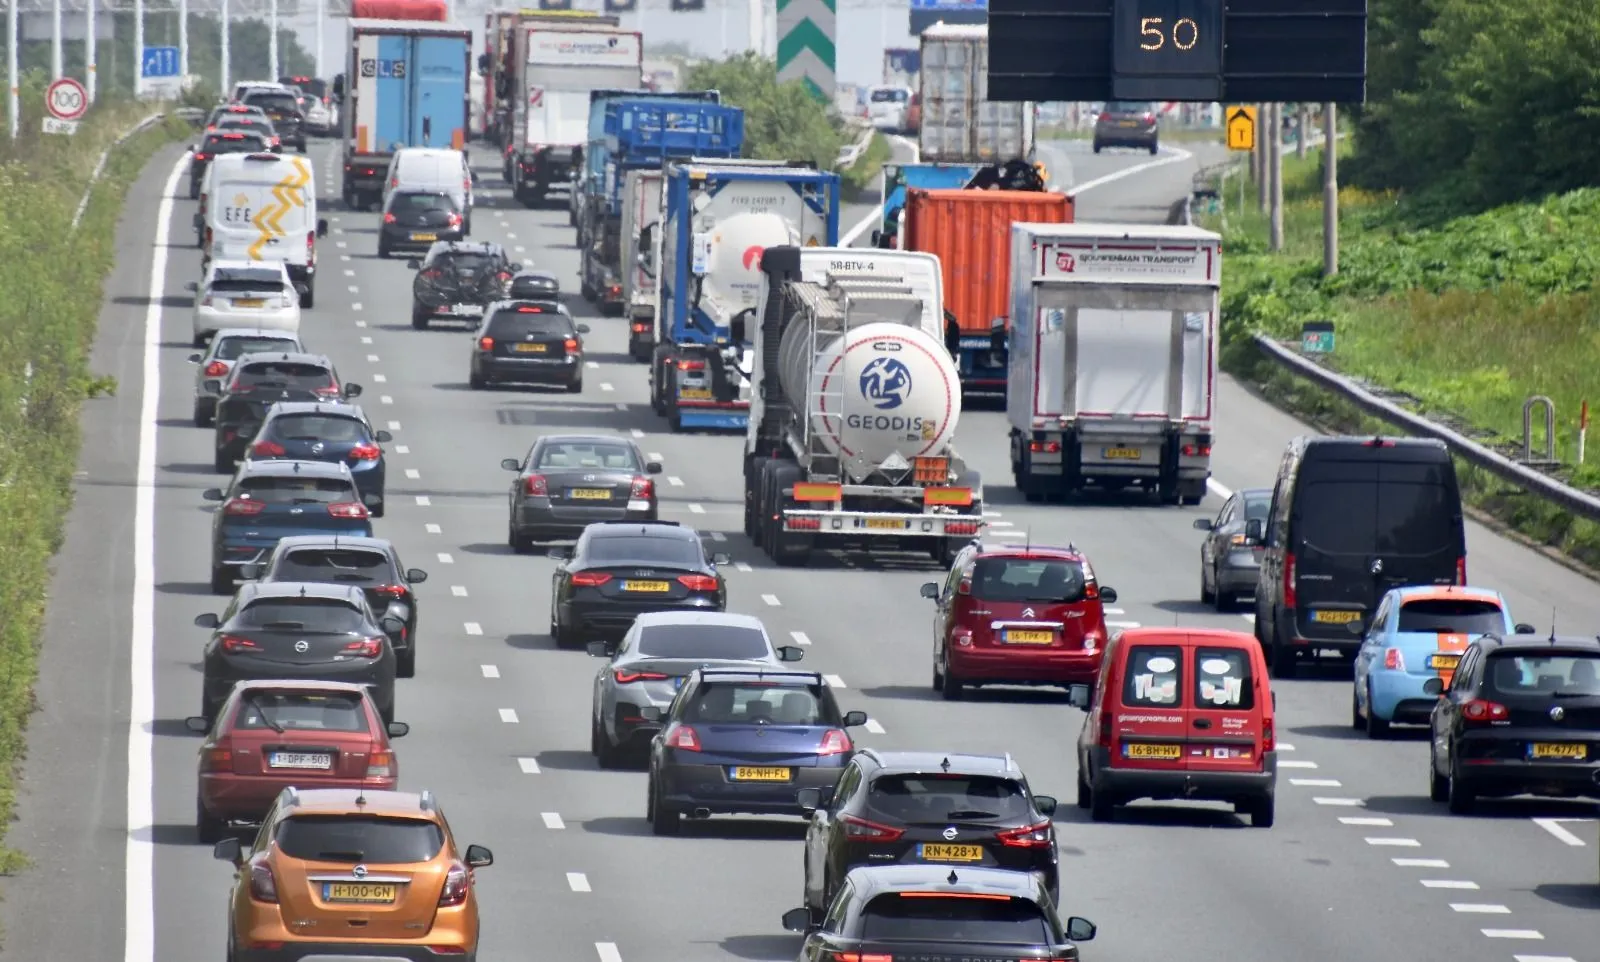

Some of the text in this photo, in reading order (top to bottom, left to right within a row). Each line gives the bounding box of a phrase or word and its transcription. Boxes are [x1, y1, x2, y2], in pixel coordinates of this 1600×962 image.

[1140, 17, 1198, 50] 50
[361, 59, 406, 78] GLS
[54, 90, 81, 108] 100
[1237, 129, 1246, 142] T
[226, 206, 251, 223] EFE
[1142, 255, 1197, 265] TRANSPORT
[847, 414, 922, 431] GEODIS
[1118, 714, 1183, 724] ginsengcreams.com
[1131, 744, 1178, 756] 16-BH-HV
[277, 754, 329, 765] 1-DPF-503
[739, 767, 786, 778] 86-NH-FL
[925, 845, 979, 857] RN-428-X
[333, 885, 391, 897] H-100-GN
